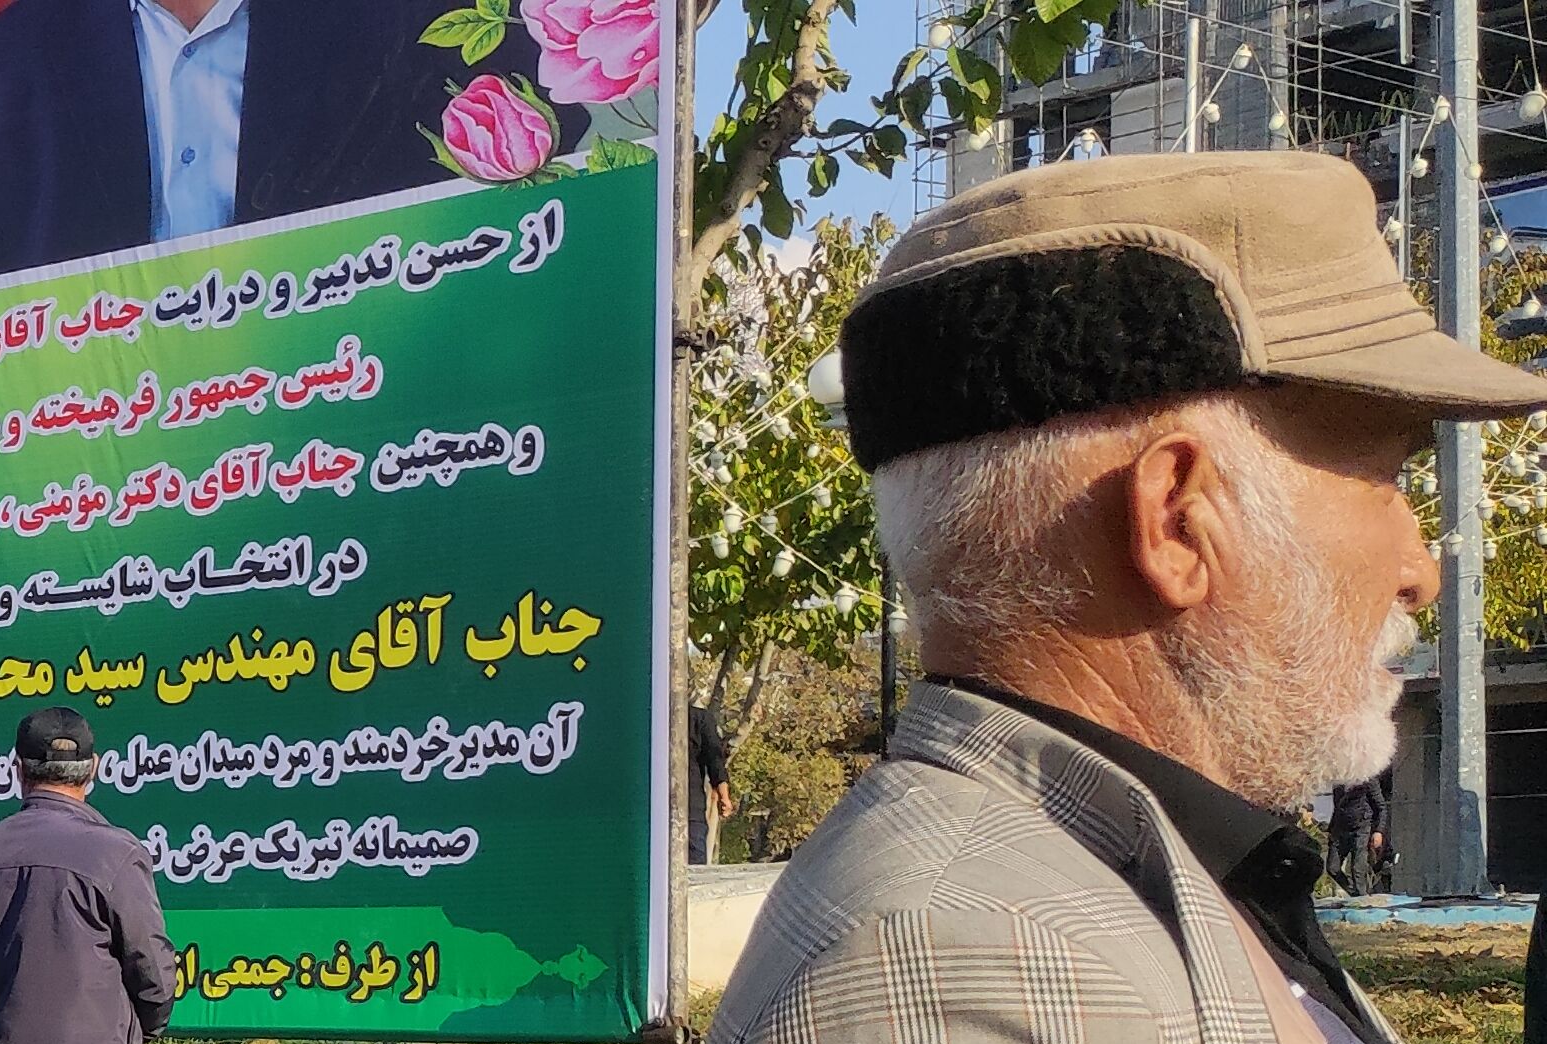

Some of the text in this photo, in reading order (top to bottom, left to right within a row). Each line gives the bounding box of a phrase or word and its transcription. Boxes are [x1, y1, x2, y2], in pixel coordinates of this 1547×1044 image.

[406, 232, 504, 285] حسن
[517, 206, 556, 268] از
[155, 271, 261, 325] درایت
[269, 276, 291, 313] و
[306, 240, 395, 306] تدبیر
[59, 296, 144, 348] جناب
[163, 369, 270, 425] جمهور
[279, 340, 377, 404] رئیس
[31, 375, 157, 434] فرهیخته
[3, 415, 21, 448] و
[376, 428, 506, 485] همچنین
[514, 431, 537, 468] و
[113, 467, 182, 521] دکتر
[190, 448, 268, 510] آقای
[275, 445, 357, 497] جناب
[22, 560, 153, 608] شایسته
[162, 542, 306, 605] انتخاب
[314, 545, 360, 591] در
[328, 593, 453, 693] آقای
[465, 591, 603, 679] جناب
[65, 646, 146, 707] سید
[156, 626, 317, 705] مهندس
[178, 735, 256, 786] میدان
[263, 738, 312, 782] مرد
[343, 723, 450, 776] خردمند
[455, 727, 520, 772] مدیر
[528, 709, 575, 767] آن
[318, 751, 332, 780] و
[169, 831, 245, 877] عرض
[256, 825, 344, 875] تبریک
[355, 822, 471, 870] صمیمانه
[202, 957, 291, 998] جمعی
[404, 944, 436, 1000] از
